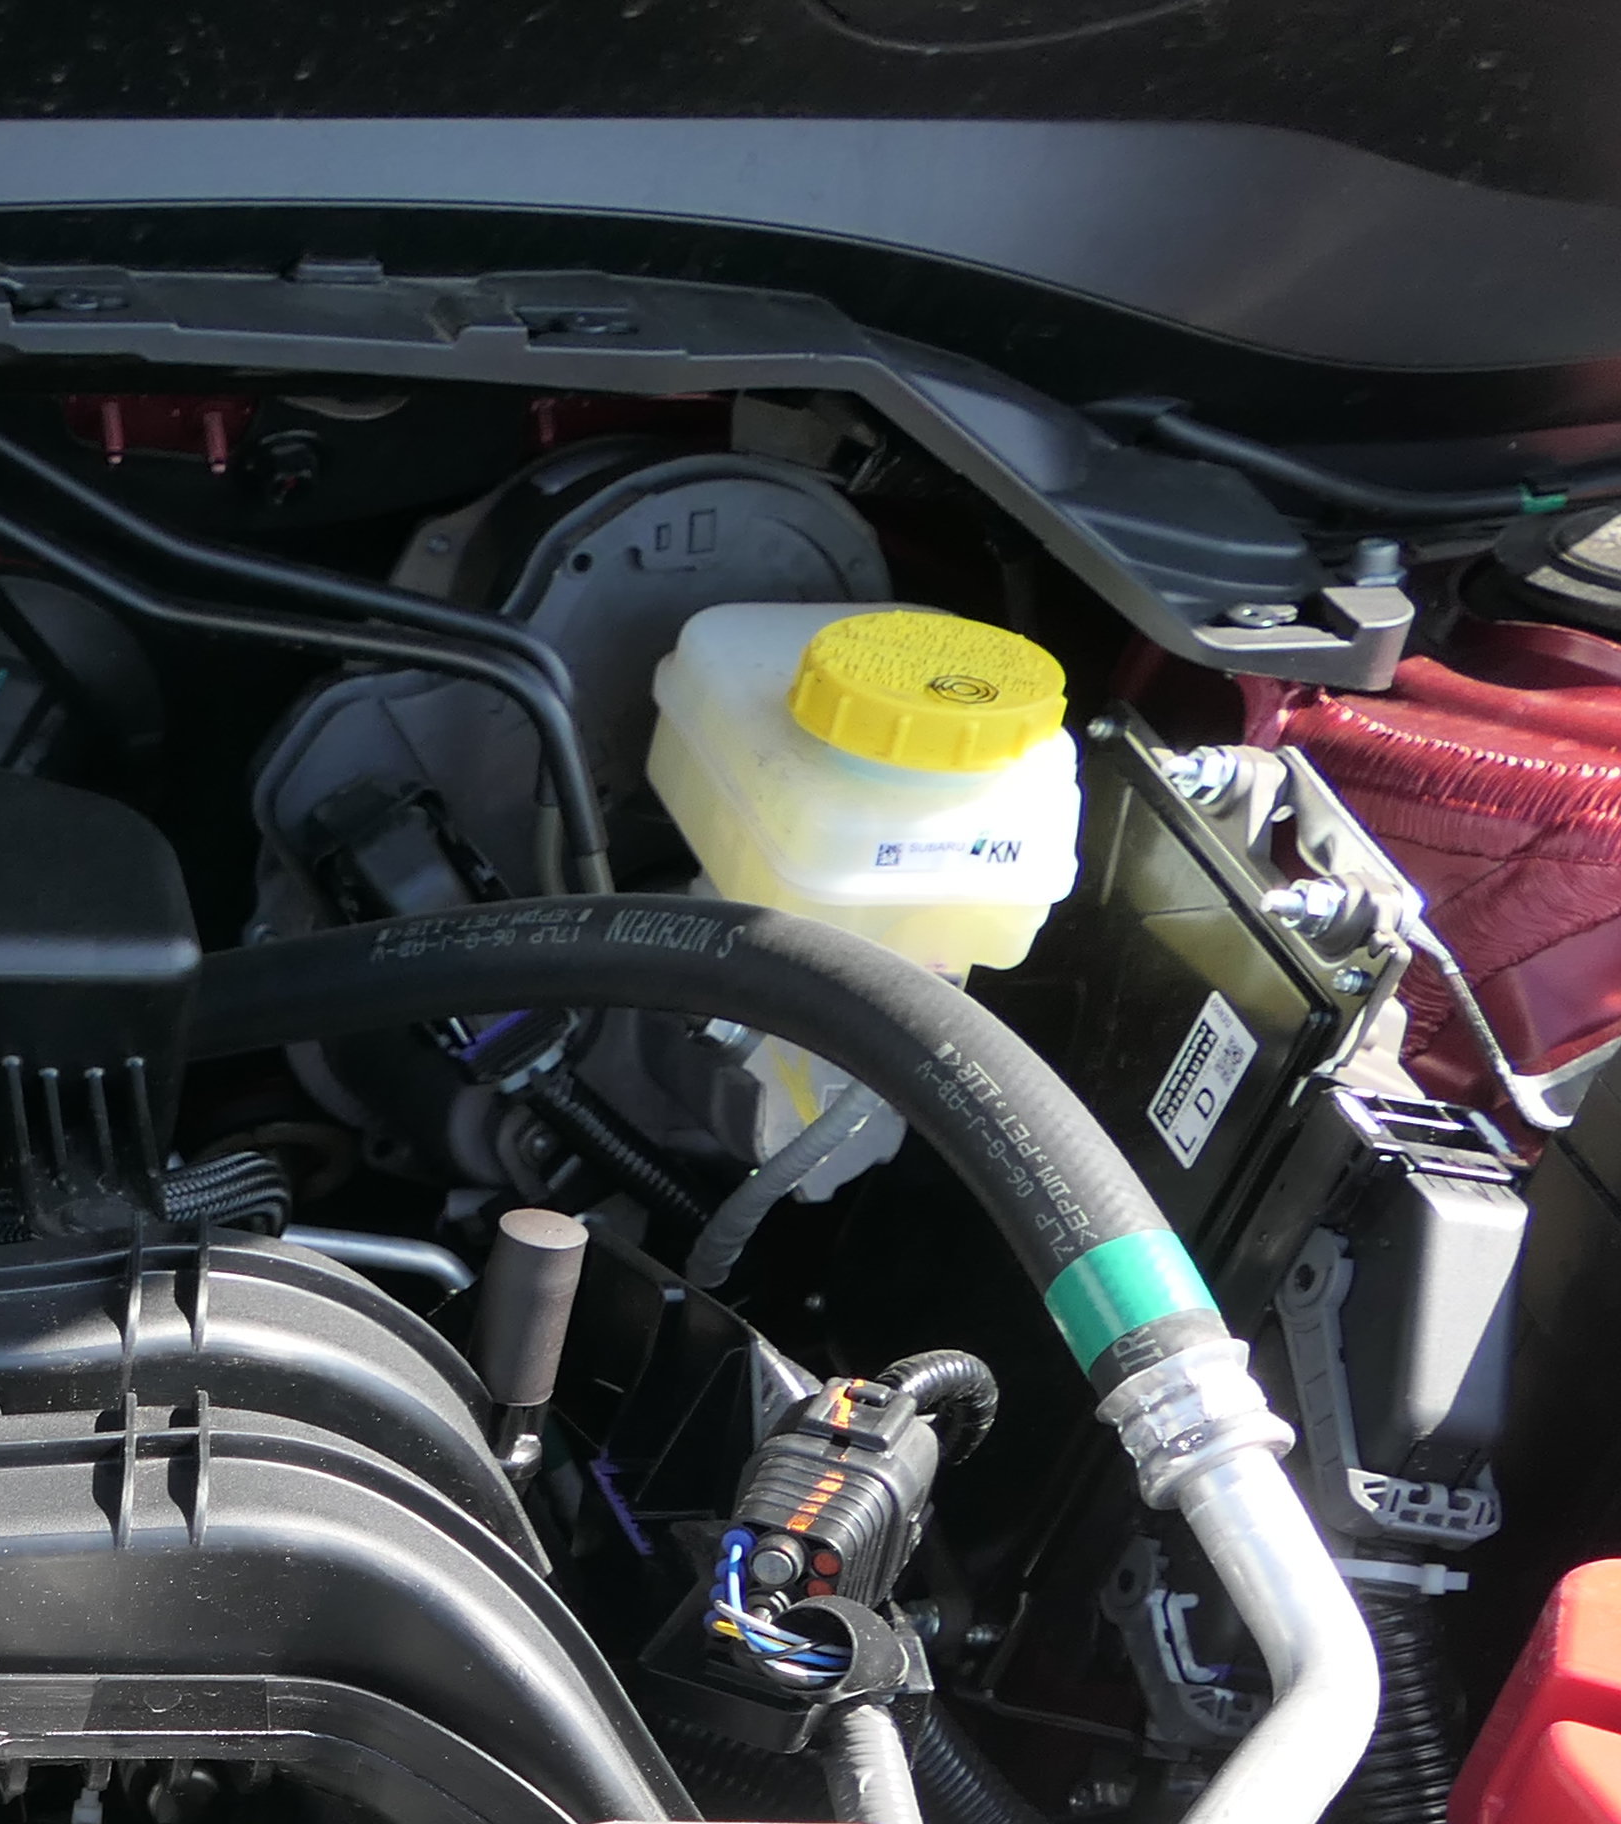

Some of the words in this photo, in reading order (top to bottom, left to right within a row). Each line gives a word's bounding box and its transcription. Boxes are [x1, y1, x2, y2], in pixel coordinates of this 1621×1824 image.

[909, 842, 966, 854] SUBARU
[986, 839, 1023, 864] KN
[1175, 1134, 1198, 1155] L
[1194, 1087, 1215, 1121] D
